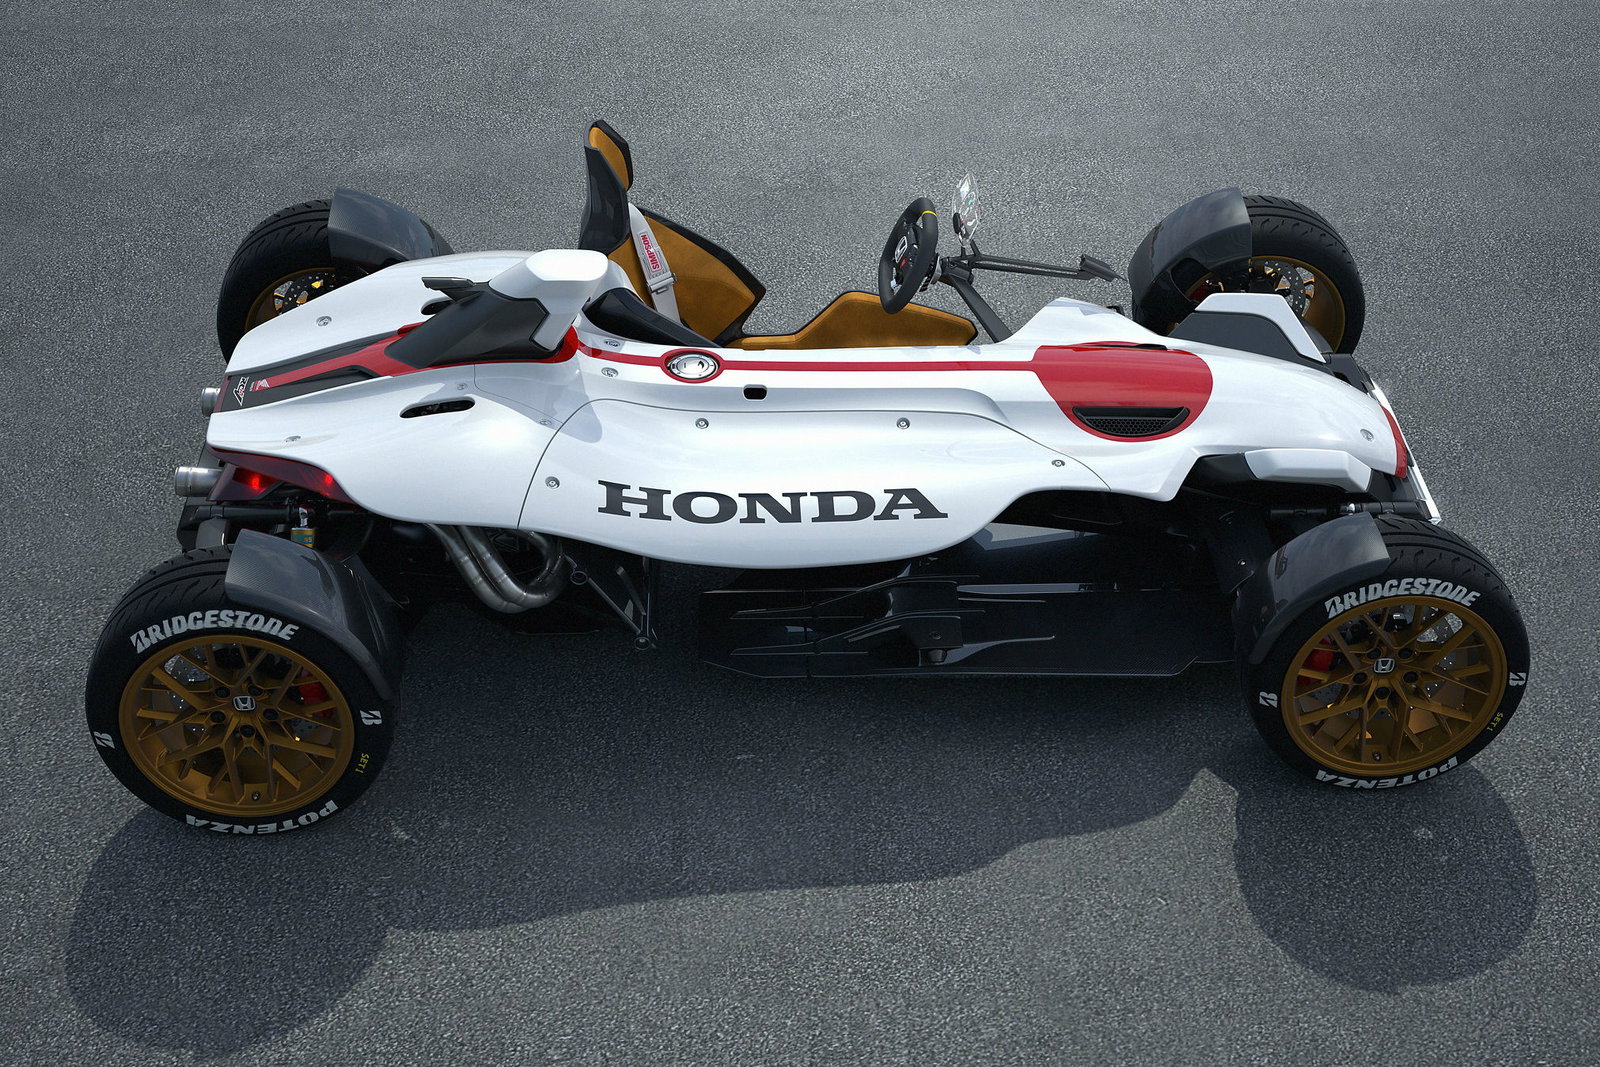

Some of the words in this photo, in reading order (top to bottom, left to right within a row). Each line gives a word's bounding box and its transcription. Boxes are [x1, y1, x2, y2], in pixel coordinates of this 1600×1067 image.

[641, 235, 660, 270] SIMPSON
[598, 480, 948, 523] HONDA
[1325, 578, 1481, 619] BRIDGESTONE
[130, 609, 299, 654] BRIDGESTONE
[1315, 756, 1459, 789] POTENZA
[185, 800, 340, 835] POTENZA
